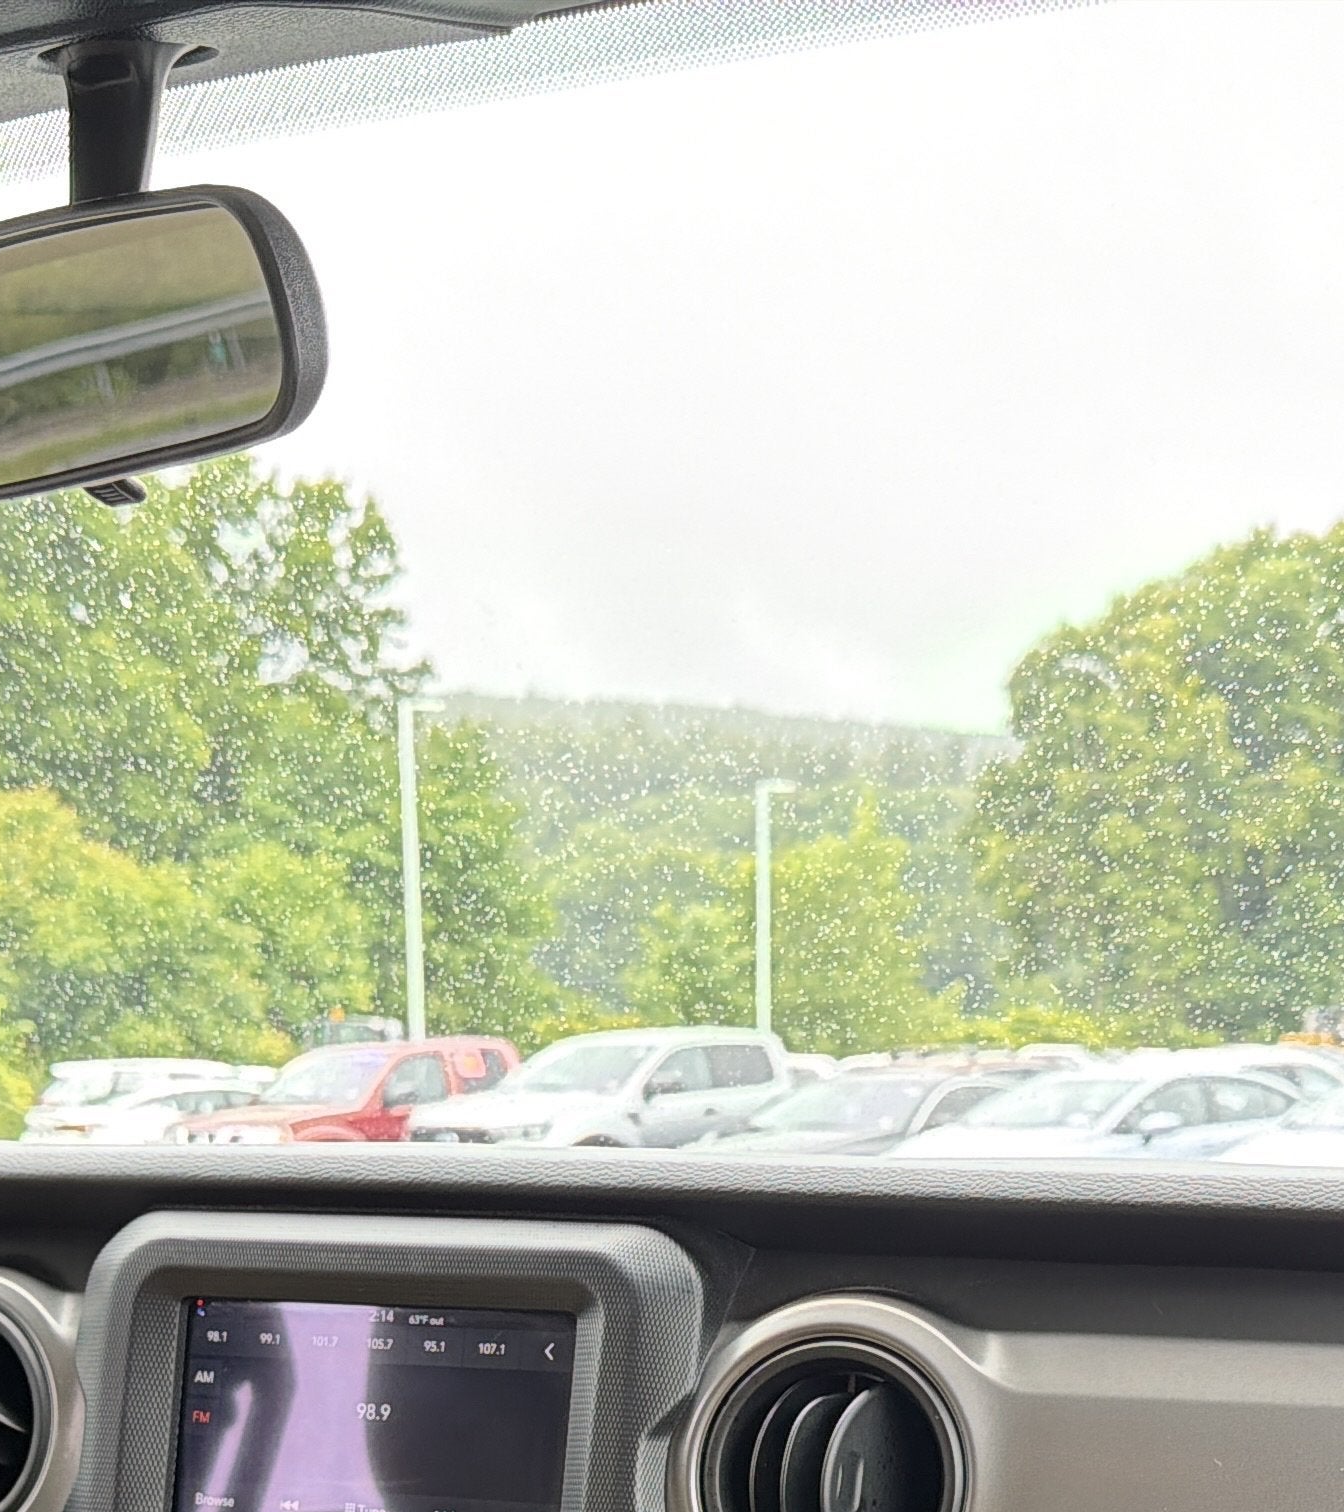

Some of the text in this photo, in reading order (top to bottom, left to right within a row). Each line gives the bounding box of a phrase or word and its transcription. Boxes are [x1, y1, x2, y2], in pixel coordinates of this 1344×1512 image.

[194, 1370, 215, 1384] AM
[192, 1409, 212, 1424] FM
[356, 1402, 392, 1422] 98.9
[194, 1491, 236, 1508] Browse
